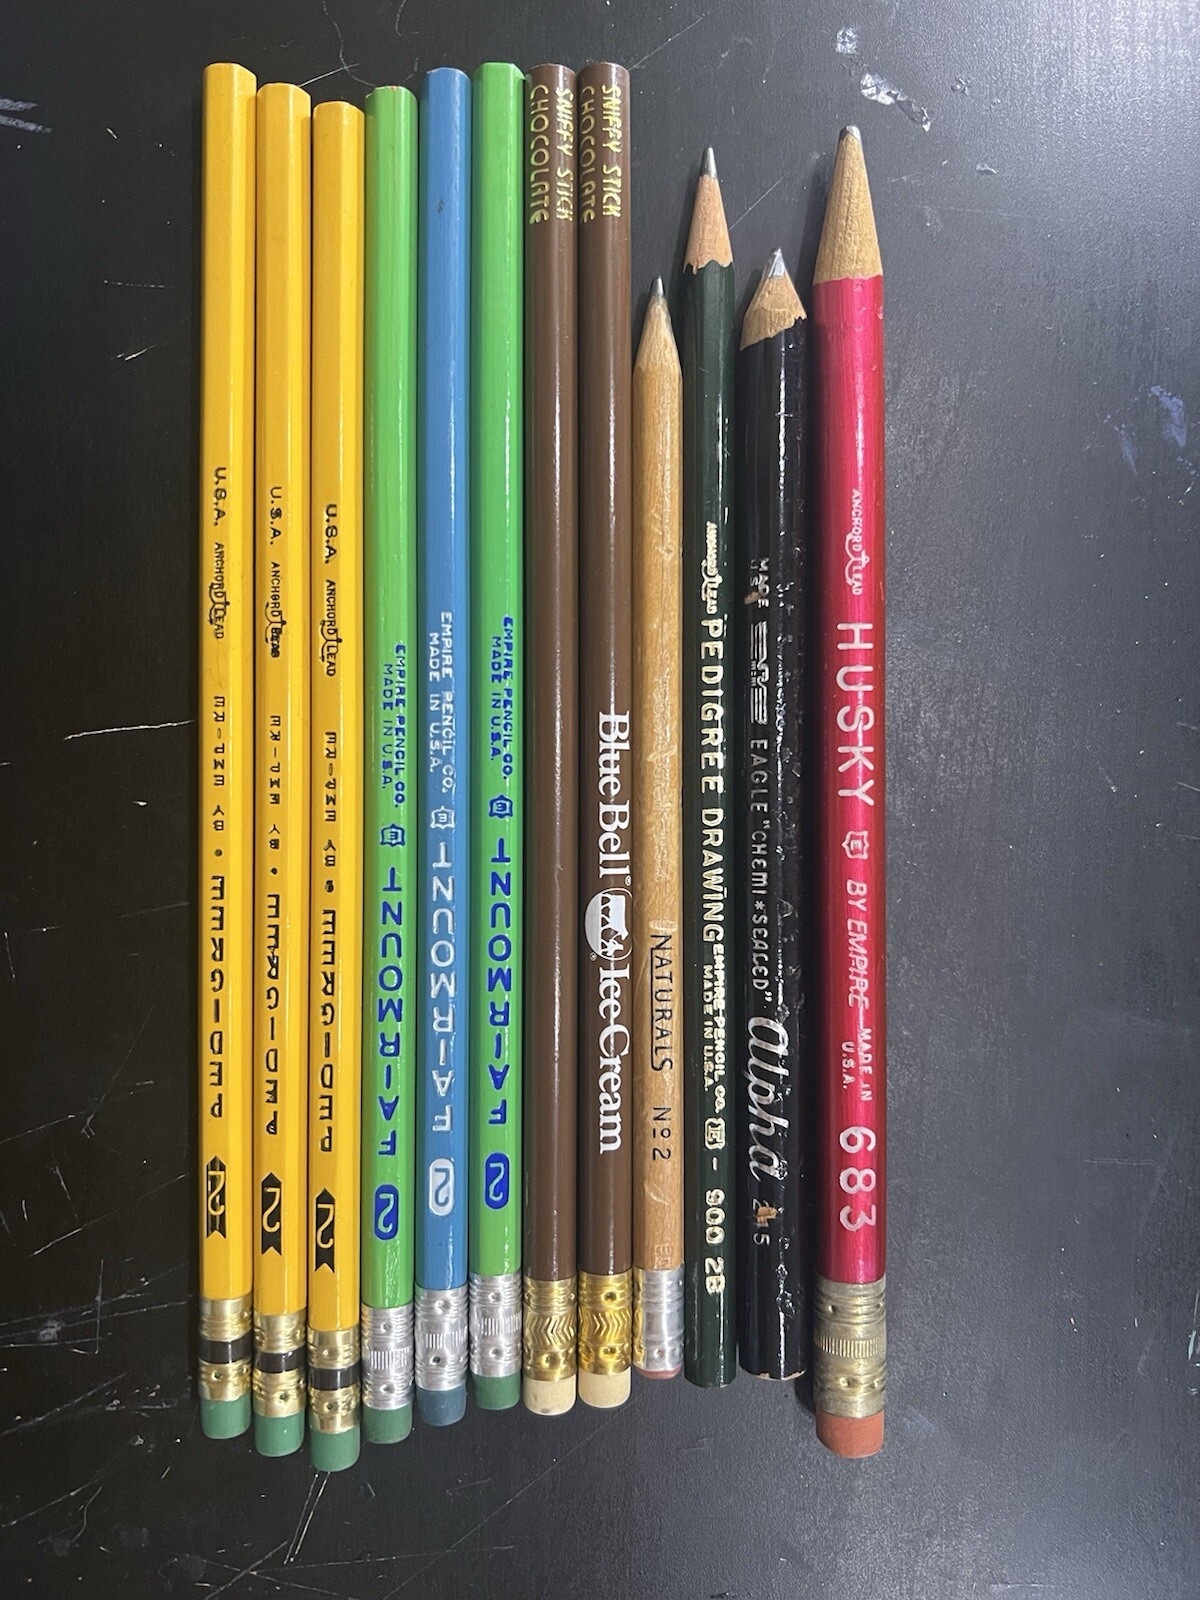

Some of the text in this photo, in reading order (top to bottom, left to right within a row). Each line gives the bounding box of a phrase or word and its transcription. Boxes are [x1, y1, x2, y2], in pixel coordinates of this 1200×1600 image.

[530, 84, 550, 224] CHOCOLATE
[556, 87, 574, 221] SNIFFY STICK
[580, 85, 597, 223] CHOCOLATE
[602, 84, 622, 218] SNIFFY STICK
[213, 467, 227, 527] U.S.A.
[270, 486, 283, 545] U.S.A.
[324, 503, 338, 564] U.S.A.
[382, 664, 393, 789] MADE IN U.S.A.
[394, 645, 407, 808] EMPIRE PENCIL CO.
[429, 632, 441, 773] MADE IN U.S.A.
[441, 611, 456, 793] EMPIRE PENCIL CO.
[490, 636, 501, 761] MADE IN U.S.A.
[503, 616, 514, 780] EMPIRE PENCIL CO.
[836, 622, 875, 806] HUSKY
[598, 710, 631, 879] Blue Bell
[701, 618, 726, 943] PEDIGREE DRAWING
[750, 739, 768, 813] EAGLE
[430, 842, 456, 1131] FAIRMOUNT
[488, 838, 512, 1124] FAIRMOUNT
[650, 934, 674, 1071] NATURALS
[846, 878, 870, 1009] BY EMPIRE
[378, 867, 403, 1155] FAIRMOUNT
[598, 962, 631, 1154] Ice Cream
[703, 965, 715, 1091] MADE IN U.S.A.
[713, 943, 726, 1114] EMPIRE PENCIL CO.
[841, 1041, 855, 1089] U.S.A.
[859, 1028, 872, 1101] MADE IN
[743, 1016, 790, 1182] Alpha
[207, 1170, 226, 1216] 2
[262, 1187, 281, 1233] 2
[316, 1203, 335, 1249] 2
[377, 1193, 394, 1234] 2
[434, 1168, 451, 1207] 2
[488, 1162, 505, 1201] 2
[705, 1188, 726, 1294] 900 2B
[838, 1125, 877, 1232] 683
